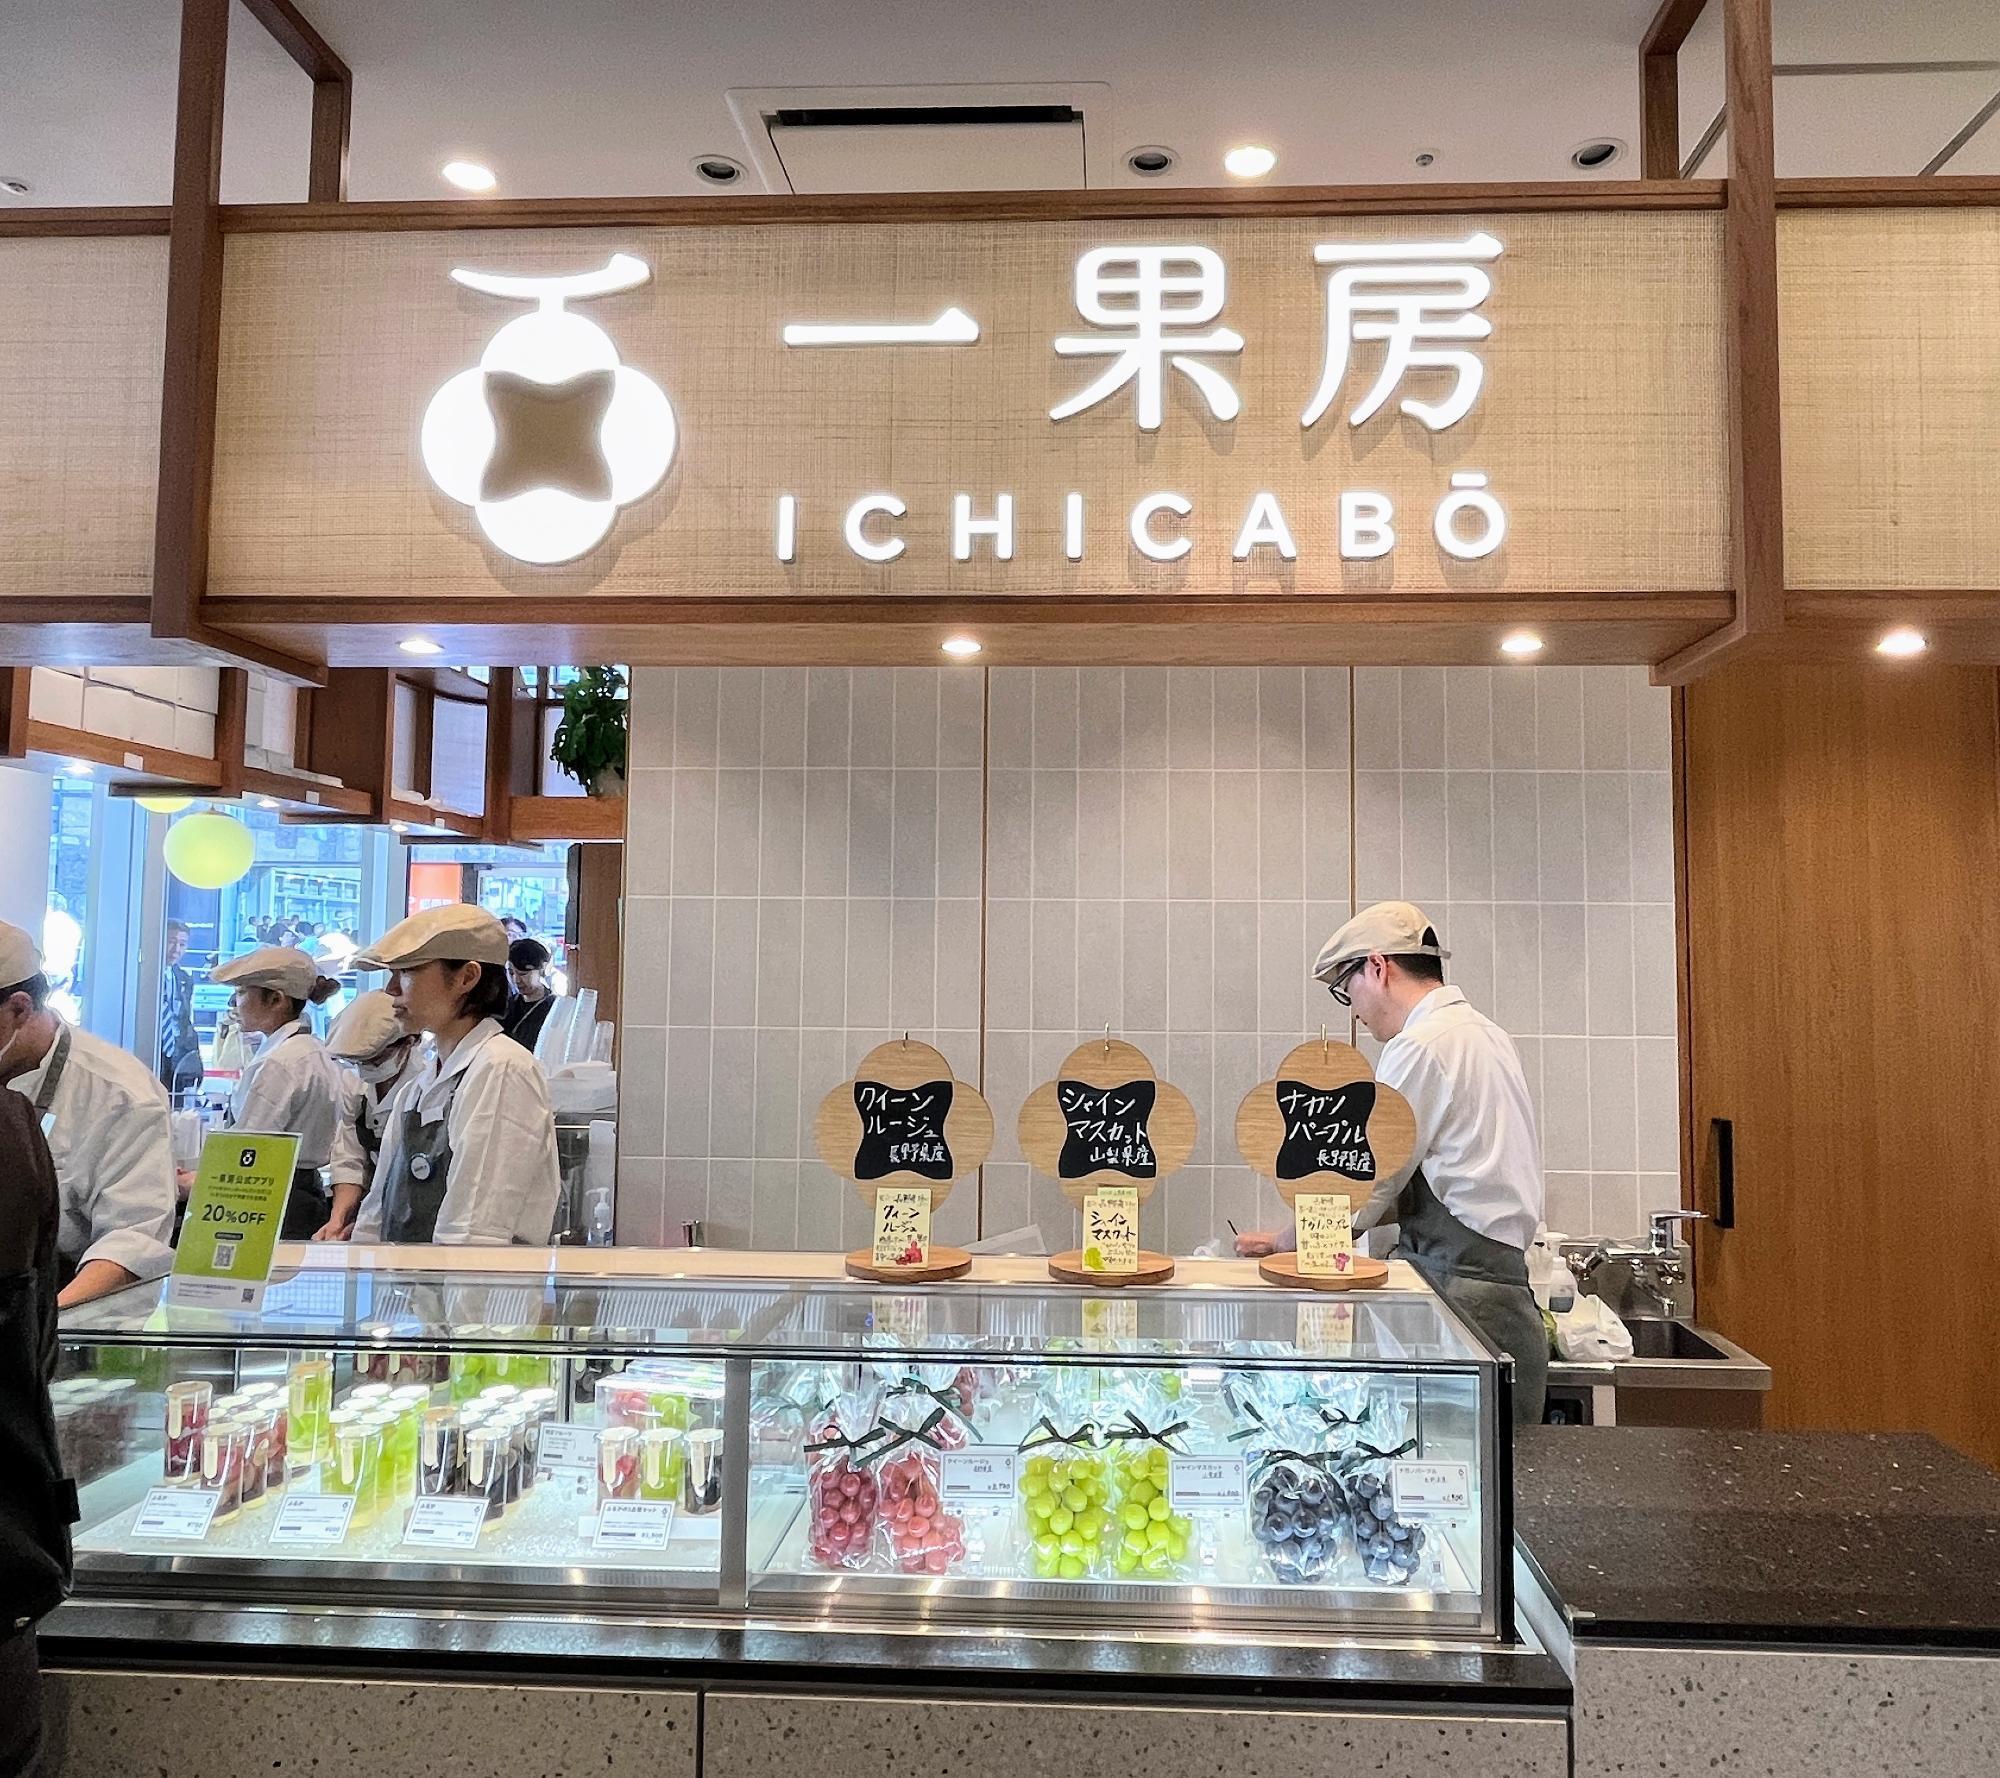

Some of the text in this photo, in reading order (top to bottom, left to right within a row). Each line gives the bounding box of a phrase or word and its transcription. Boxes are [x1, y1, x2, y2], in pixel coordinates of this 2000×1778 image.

[784, 233, 1502, 429] 一果房
[778, 473, 1506, 561] ICHICABŌ
[1061, 1087, 1136, 1116] シャイン
[1280, 1089, 1347, 1117] ナガノ
[867, 1114, 940, 1138] ルージュ
[1067, 1119, 1147, 1145] マスカット
[1288, 1119, 1366, 1144] パープル
[201, 1203, 267, 1225] 20%OFF
